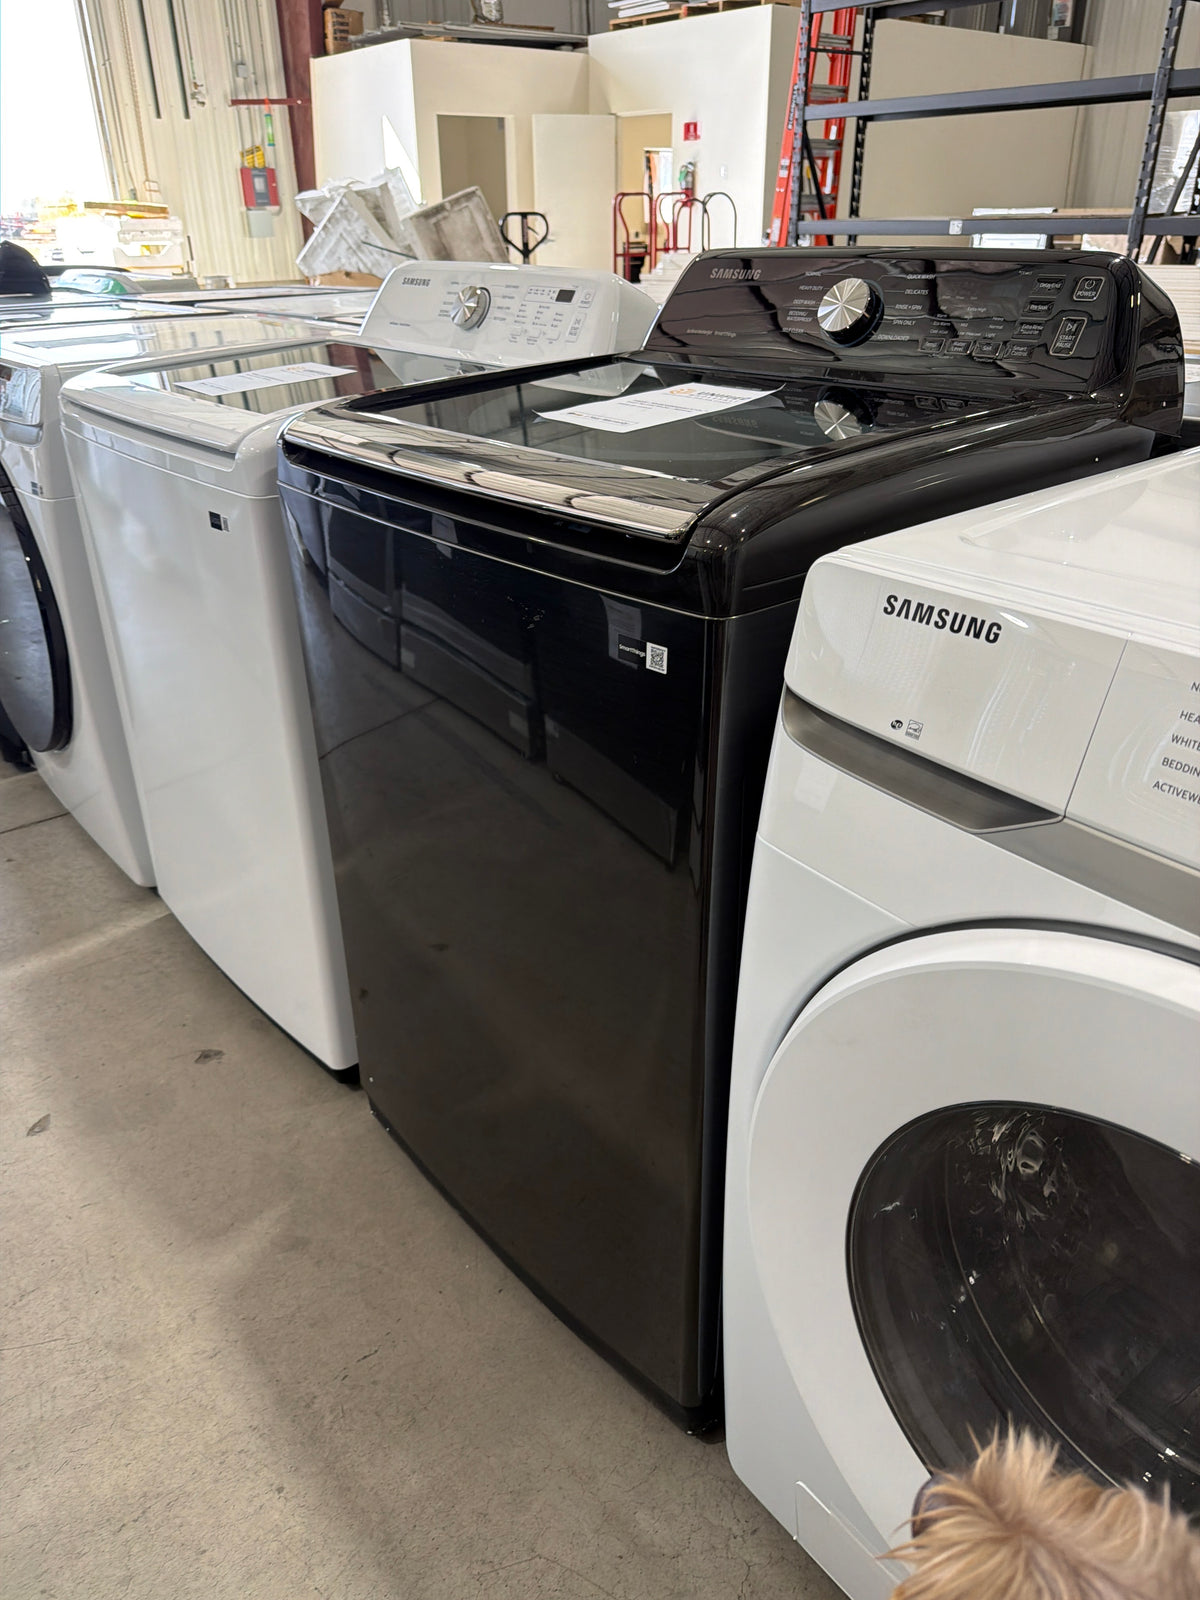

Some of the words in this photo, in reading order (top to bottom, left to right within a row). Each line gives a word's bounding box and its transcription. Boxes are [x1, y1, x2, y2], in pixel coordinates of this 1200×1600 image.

[710, 268, 762, 280] SAMSUNG
[402, 277, 431, 287] SAMSUNG
[883, 594, 1002, 644] SAMSUNG
[619, 644, 646, 658] SmartThings
[1162, 757, 1200, 777] BEDDIN
